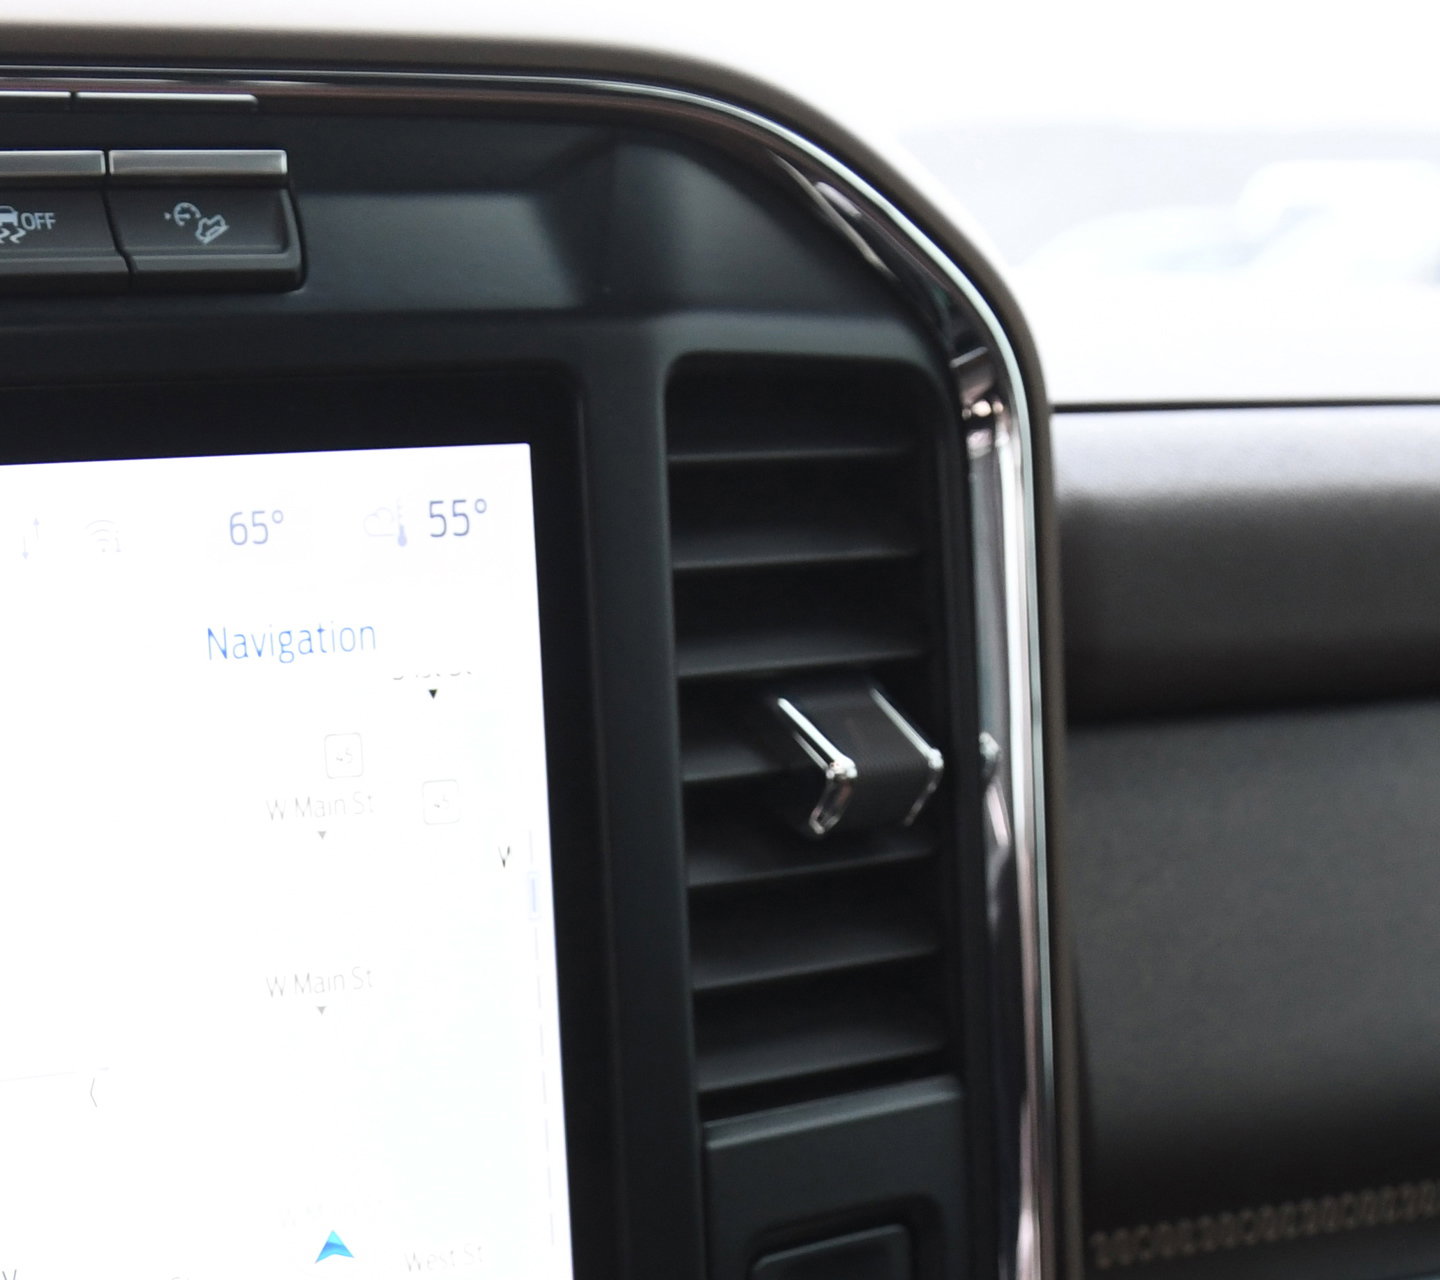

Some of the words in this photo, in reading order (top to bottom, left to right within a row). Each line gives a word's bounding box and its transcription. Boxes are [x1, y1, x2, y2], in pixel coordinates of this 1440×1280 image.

[19, 211, 56, 232] OFF
[229, 510, 283, 546] 65°
[429, 499, 487, 538] 55°
[207, 623, 376, 664] Navigation
[265, 799, 287, 822] W
[295, 796, 346, 817] Main
[353, 791, 374, 814] St
[265, 974, 287, 998] W
[294, 972, 344, 994] Main
[352, 966, 373, 990] St
